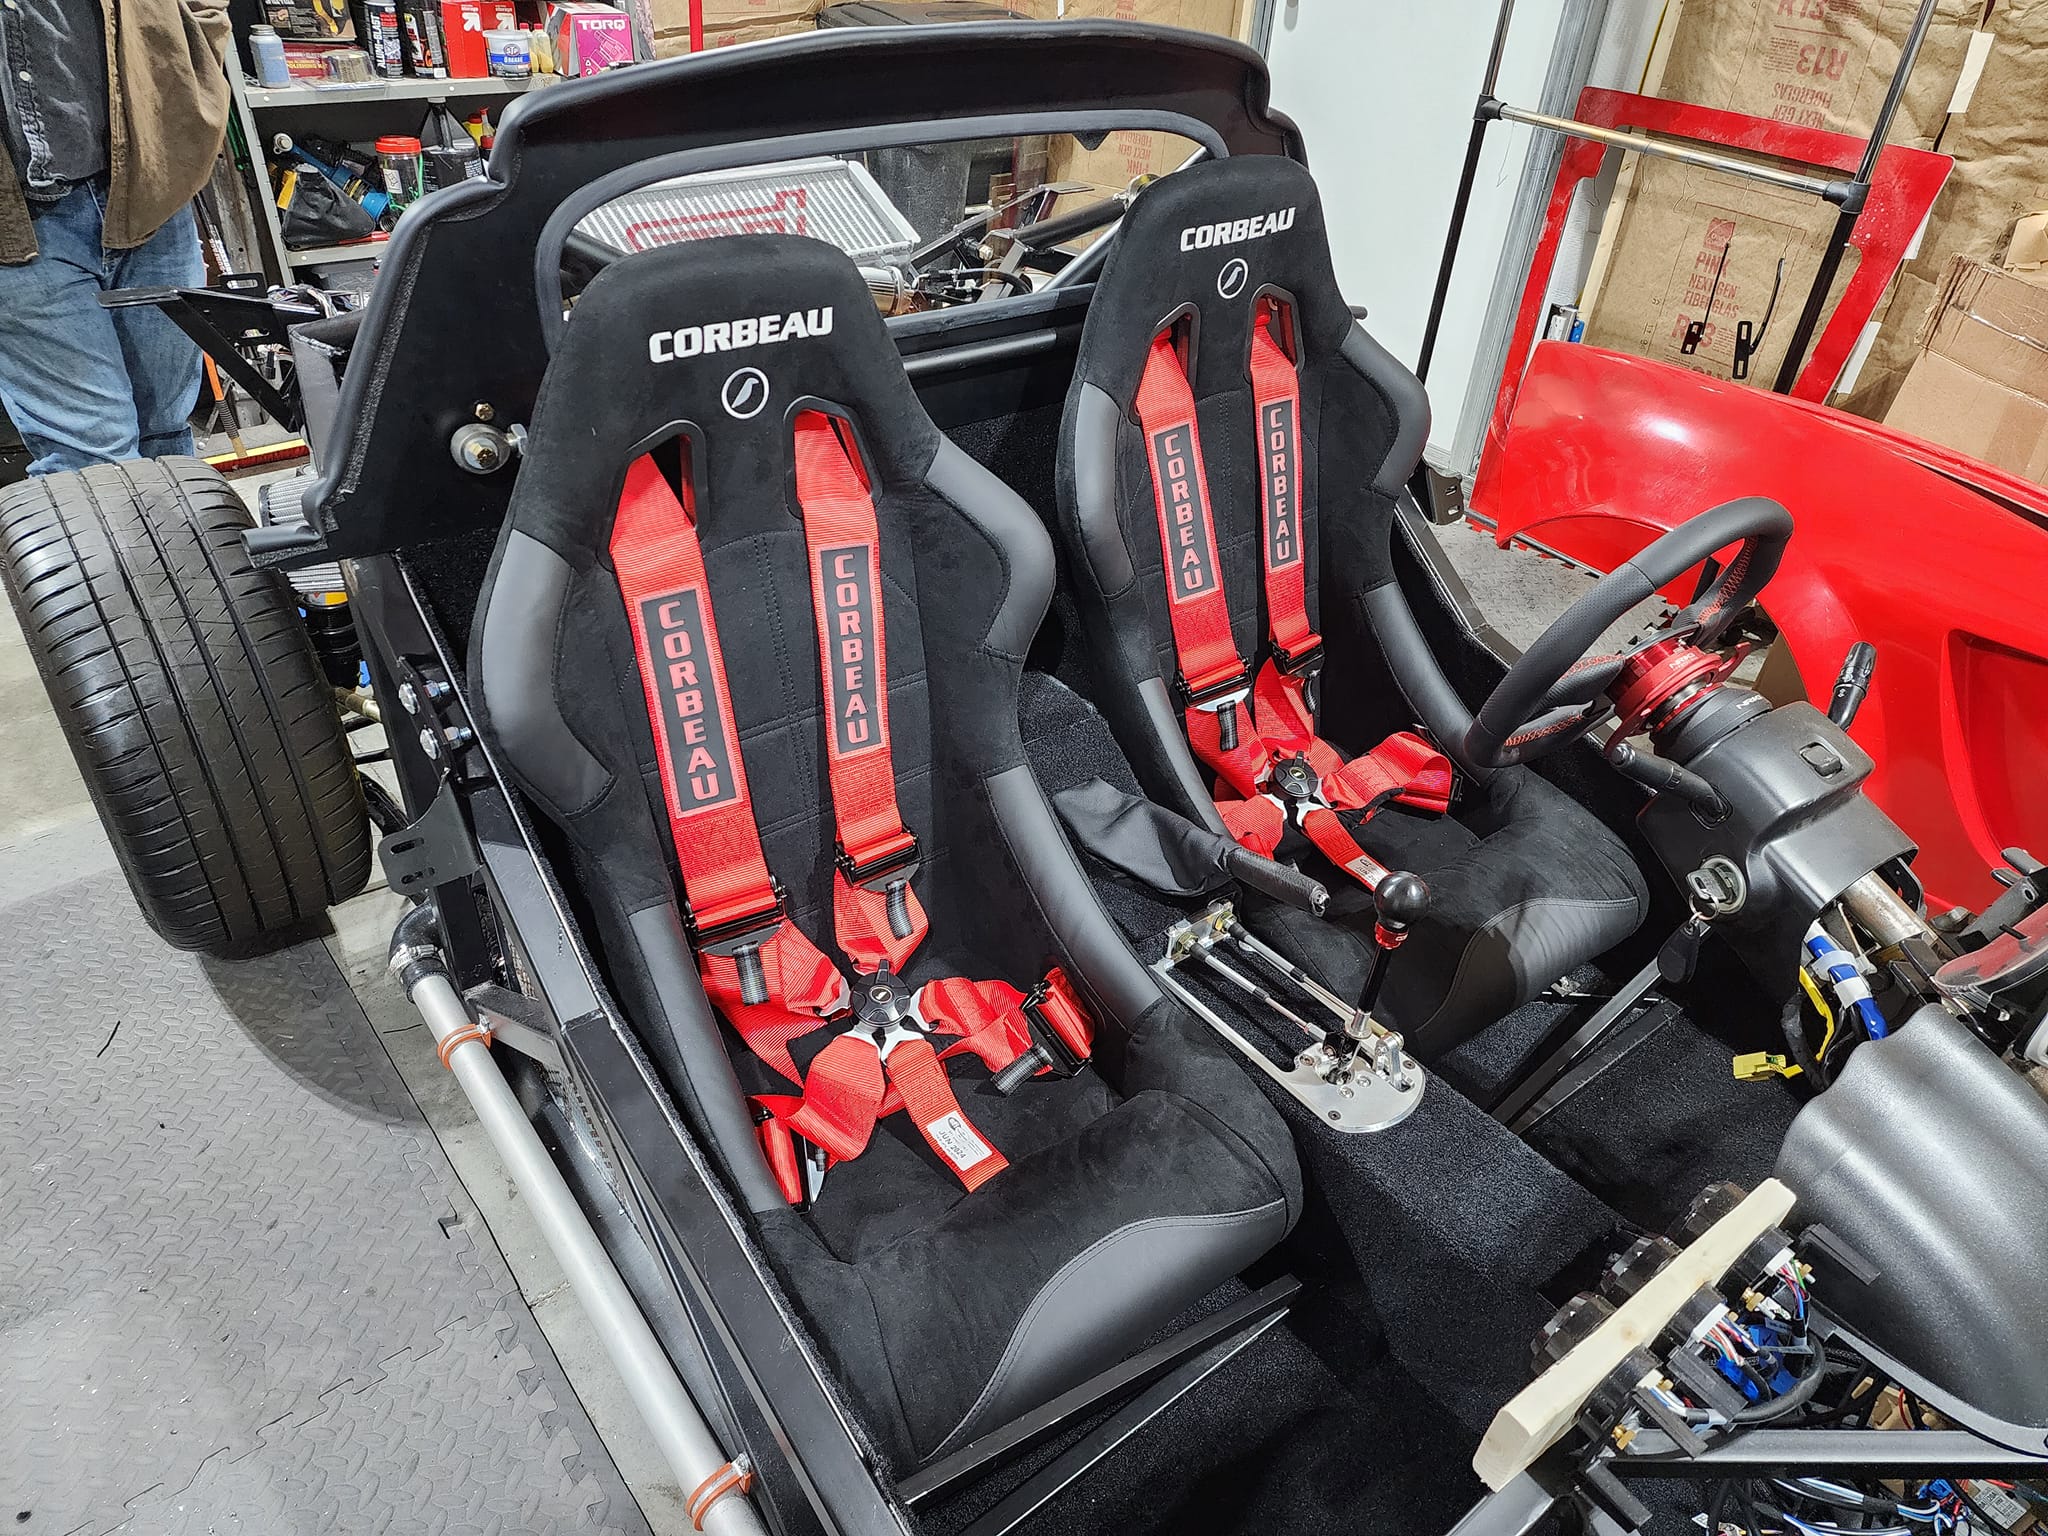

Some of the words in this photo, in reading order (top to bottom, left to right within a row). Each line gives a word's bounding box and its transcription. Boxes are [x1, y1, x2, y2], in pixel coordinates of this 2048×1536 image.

[577, 19, 626, 31] TORQ
[1796, 44, 1849, 81] R13
[1772, 82, 1833, 109] FIBERGLAS
[1773, 104, 1797, 123] GEN
[1801, 106, 1826, 129] NEXT
[1126, 158, 1150, 175] PINK
[1180, 207, 1296, 252] CORBEAU
[1718, 281, 1738, 300] GEN
[649, 306, 833, 364] CORBEAU
[1671, 313, 1717, 348] R3
[1269, 407, 1290, 560] CORBEAU
[1164, 433, 1202, 591] CORBEAU
[833, 552, 870, 744] CORBEAU
[657, 600, 721, 800] CORBEAU
[1736, 694, 1762, 709] NRG
[938, 1130, 953, 1145] JUN
[950, 1144, 966, 1158] 2024
